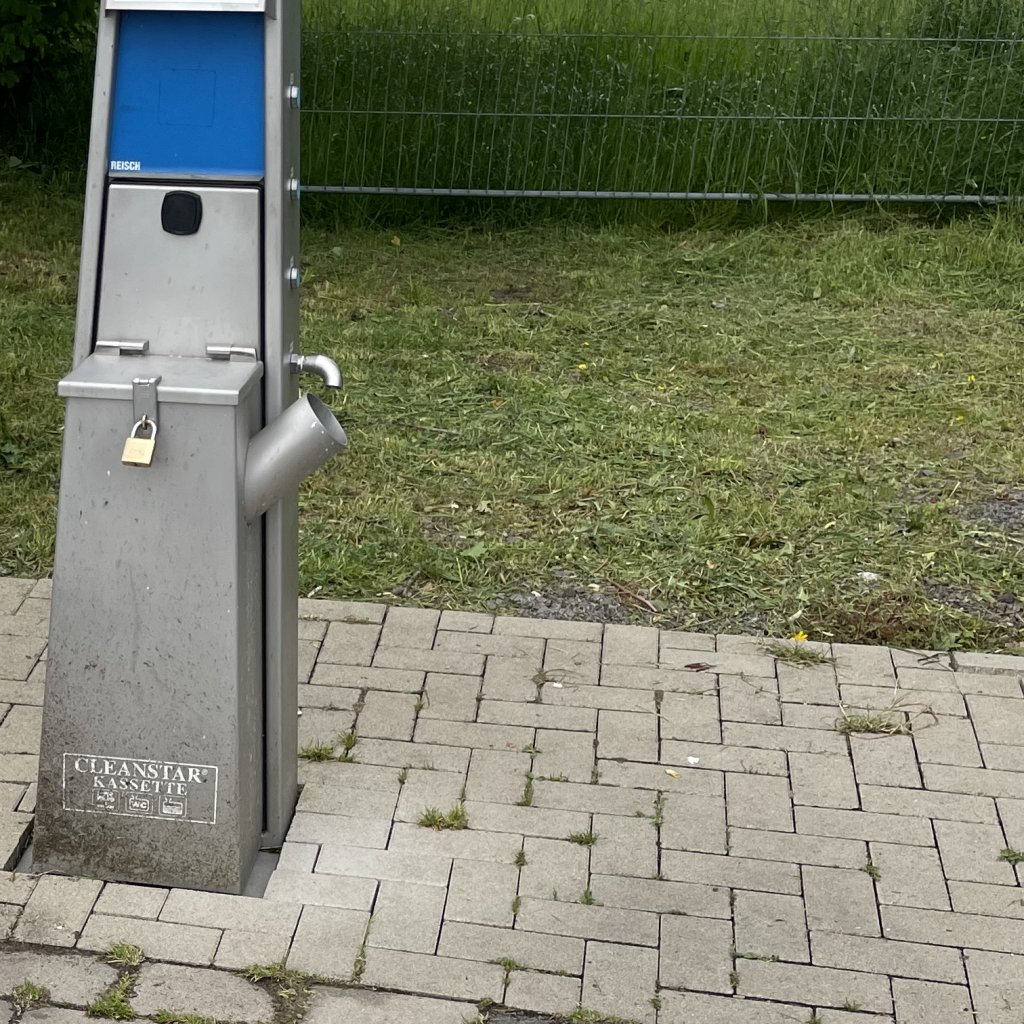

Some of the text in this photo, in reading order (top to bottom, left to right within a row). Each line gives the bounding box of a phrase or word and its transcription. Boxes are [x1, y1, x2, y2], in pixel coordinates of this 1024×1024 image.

[110, 160, 141, 171] REISCH
[93, 775, 188, 796] KASSETTE
[131, 801, 147, 809] WC
